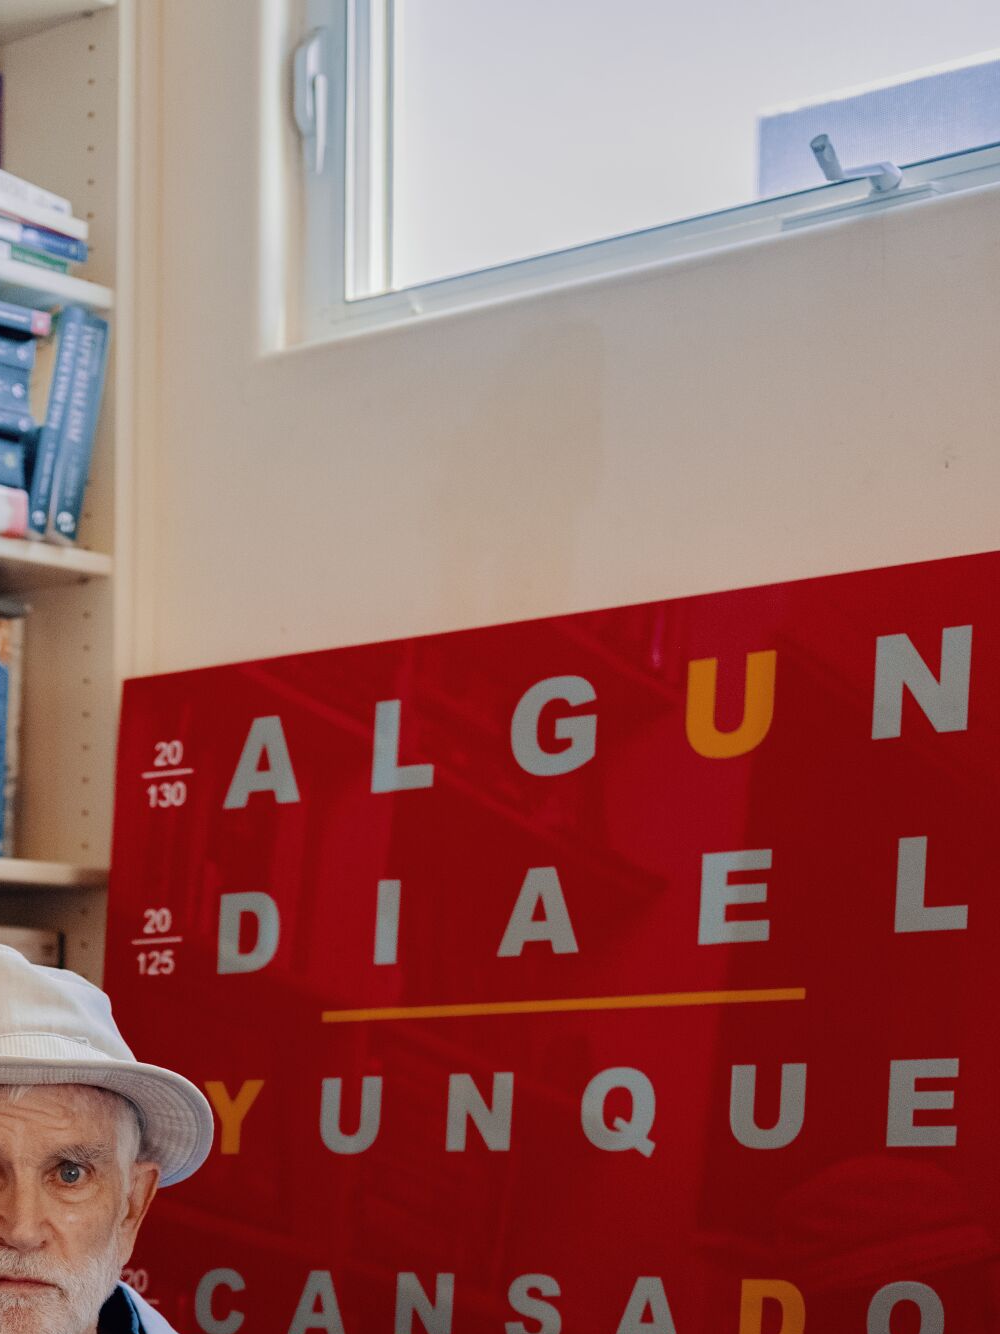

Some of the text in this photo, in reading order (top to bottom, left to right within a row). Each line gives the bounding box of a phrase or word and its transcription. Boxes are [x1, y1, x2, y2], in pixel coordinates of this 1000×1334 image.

[153, 739, 184, 767] 20
[147, 781, 188, 808] 130
[142, 907, 173, 934] 20
[137, 949, 176, 976] 125
